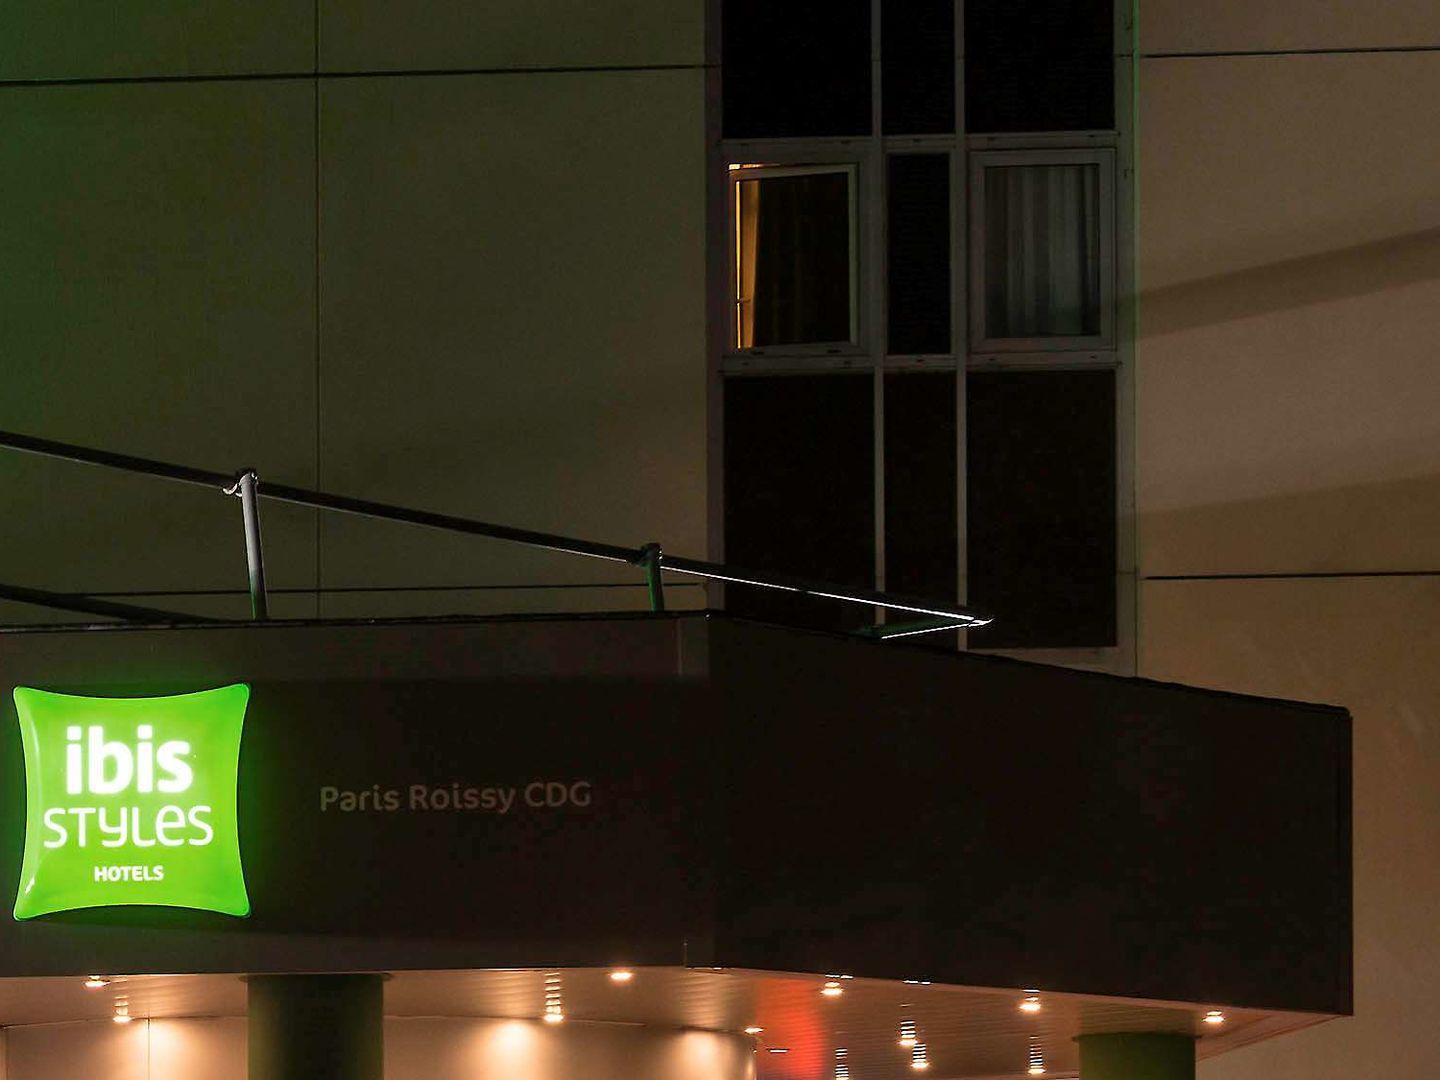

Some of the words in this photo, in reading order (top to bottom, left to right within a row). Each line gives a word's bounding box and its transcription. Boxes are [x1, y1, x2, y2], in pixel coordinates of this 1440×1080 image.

[66, 724, 193, 795] ibis
[319, 784, 401, 812] Paris
[408, 782, 516, 815] Roissy
[524, 780, 593, 808] CDG
[94, 865, 164, 882] HOTELS
